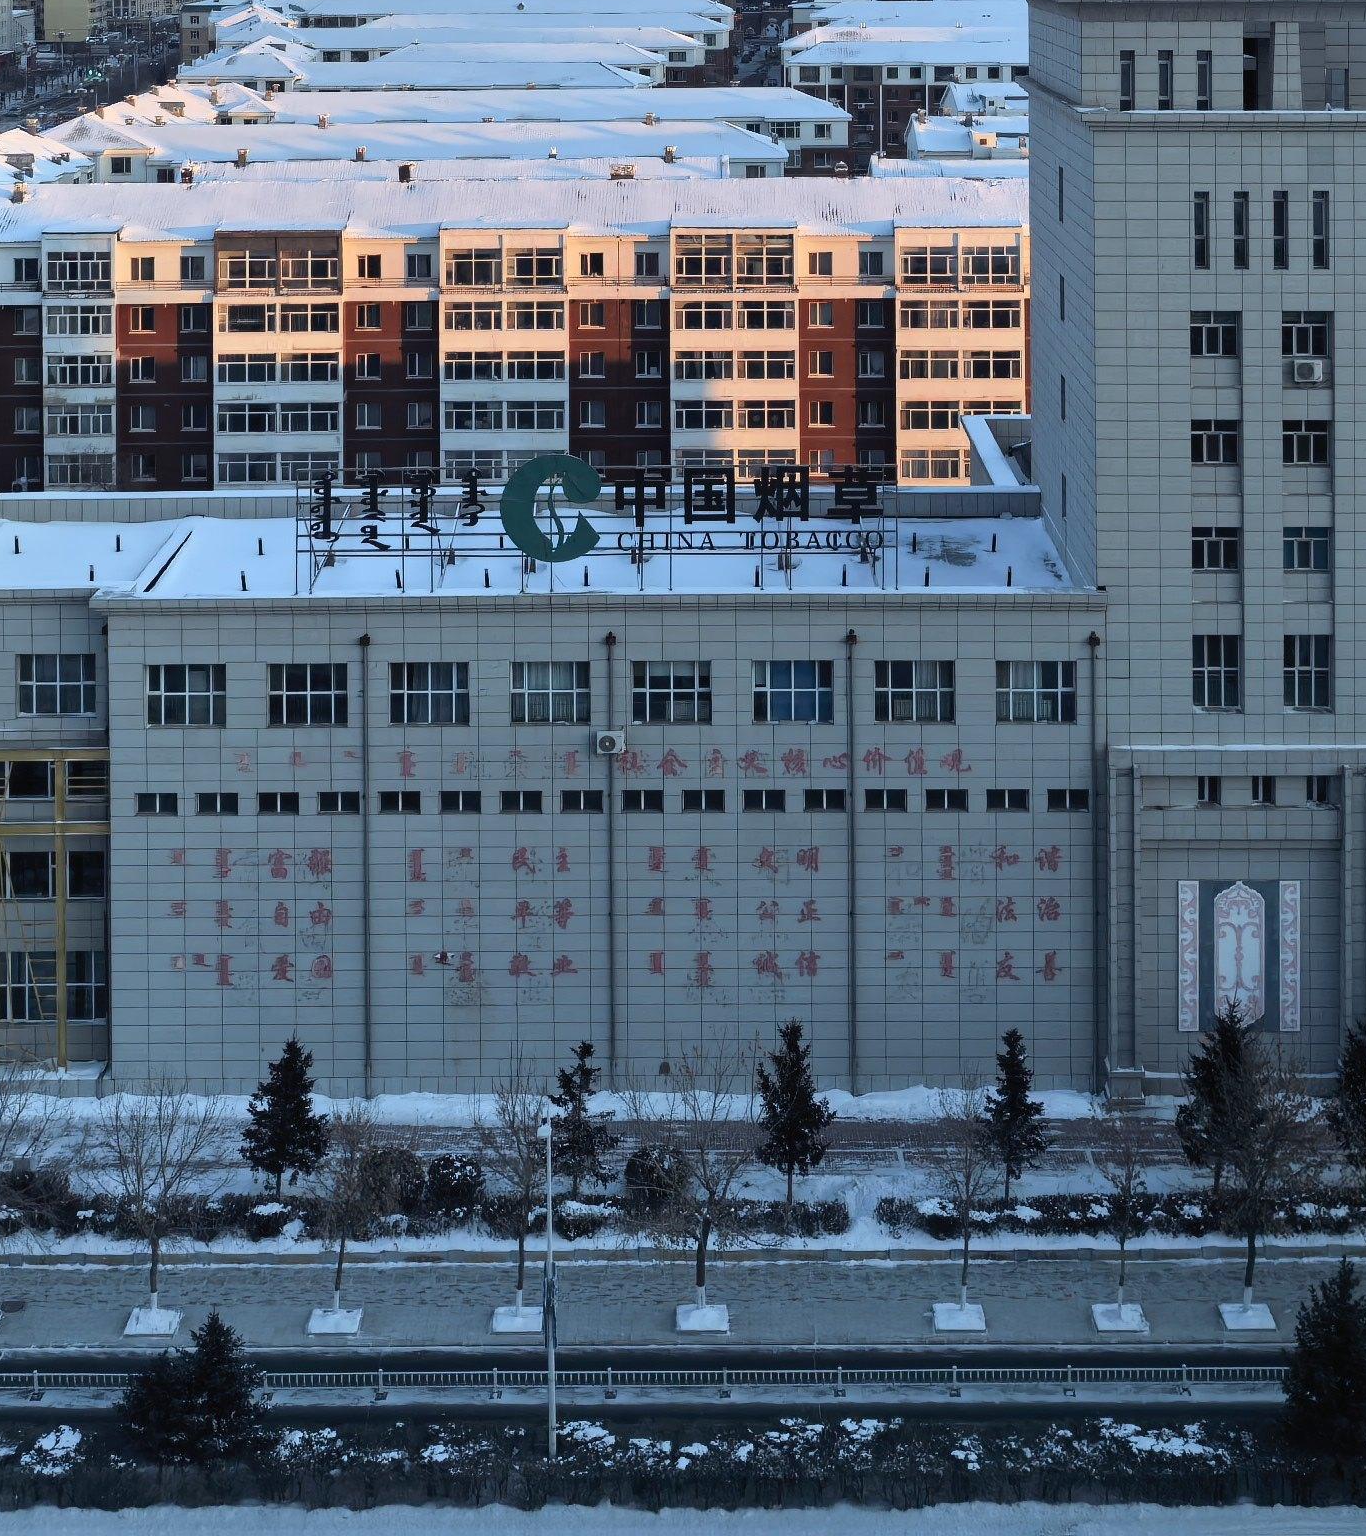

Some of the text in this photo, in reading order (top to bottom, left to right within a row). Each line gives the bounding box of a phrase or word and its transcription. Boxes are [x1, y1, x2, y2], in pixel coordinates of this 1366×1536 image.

[615, 465, 884, 527] 中国烟草
[617, 531, 884, 551] CHINA TOBACCO
[752, 846, 820, 873] 文明
[990, 845, 1062, 872] 和谐
[274, 901, 333, 928] 自由
[996, 896, 1061, 922] 法治
[996, 950, 1063, 982] 友善
